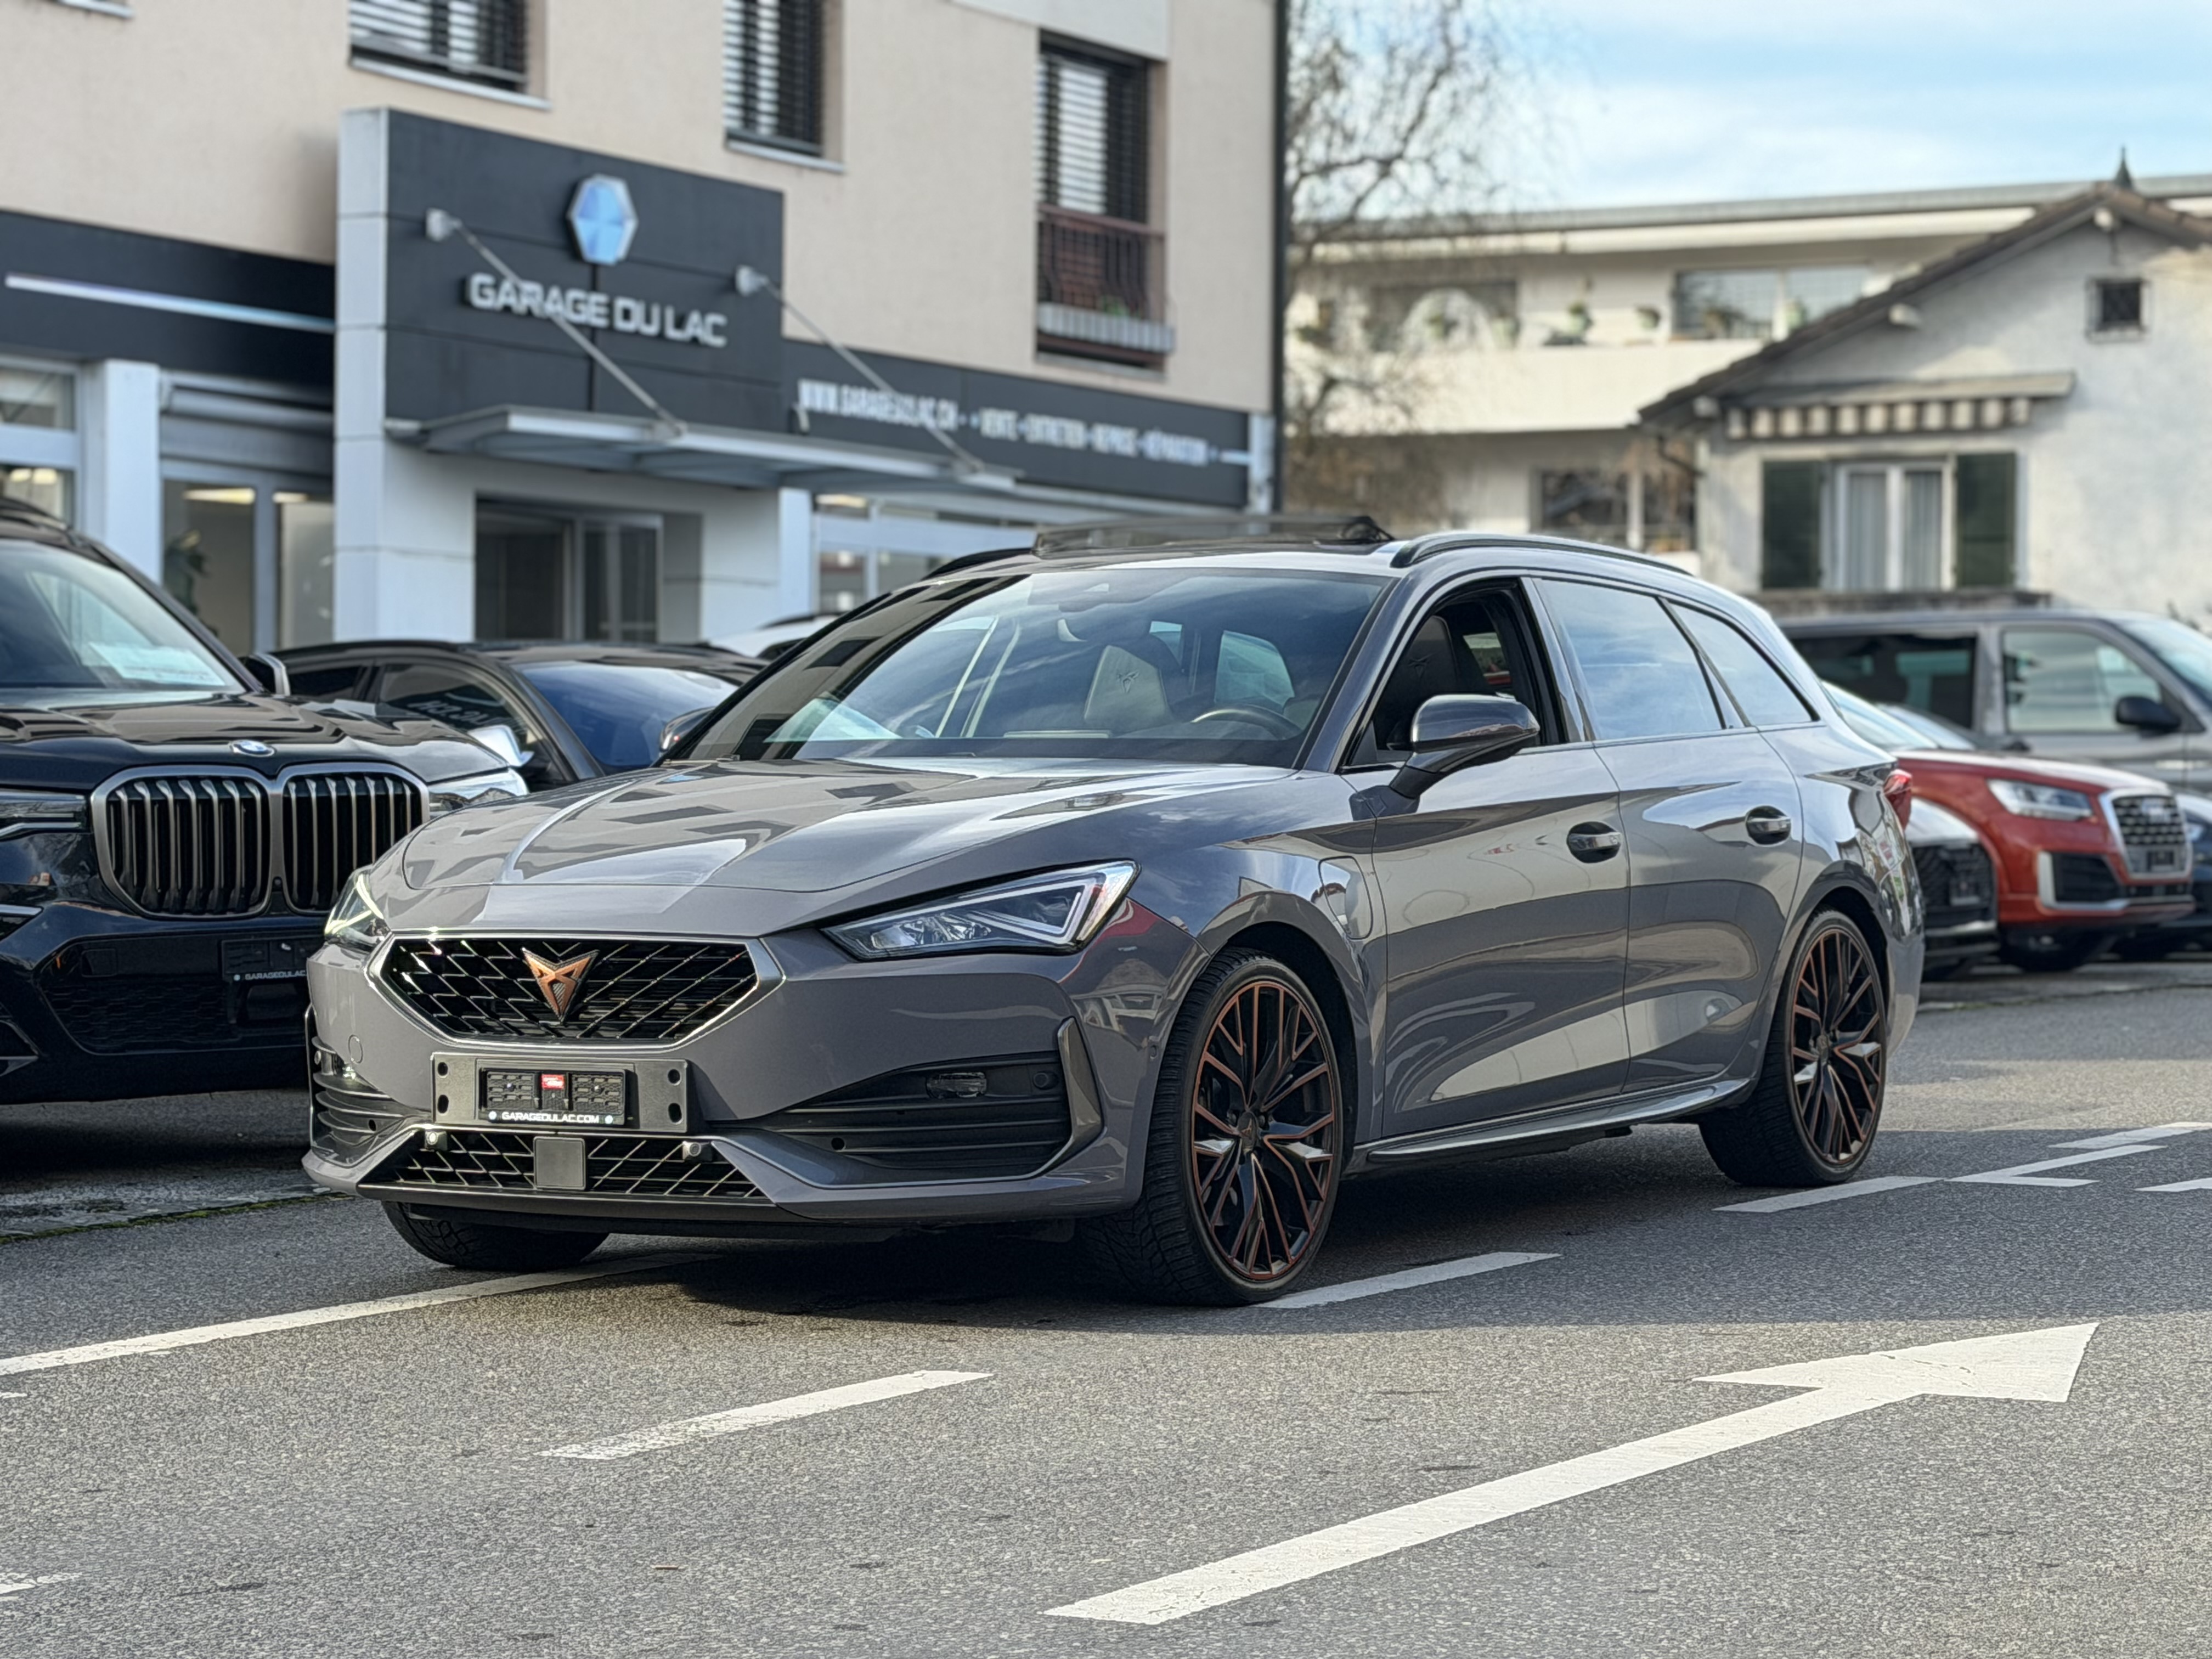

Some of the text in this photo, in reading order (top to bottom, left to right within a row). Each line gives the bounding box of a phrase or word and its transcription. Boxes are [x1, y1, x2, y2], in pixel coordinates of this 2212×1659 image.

[469, 273, 727, 348] GARAGE DU LAC
[501, 1111, 599, 1123] GARAGEDULAC.COM
